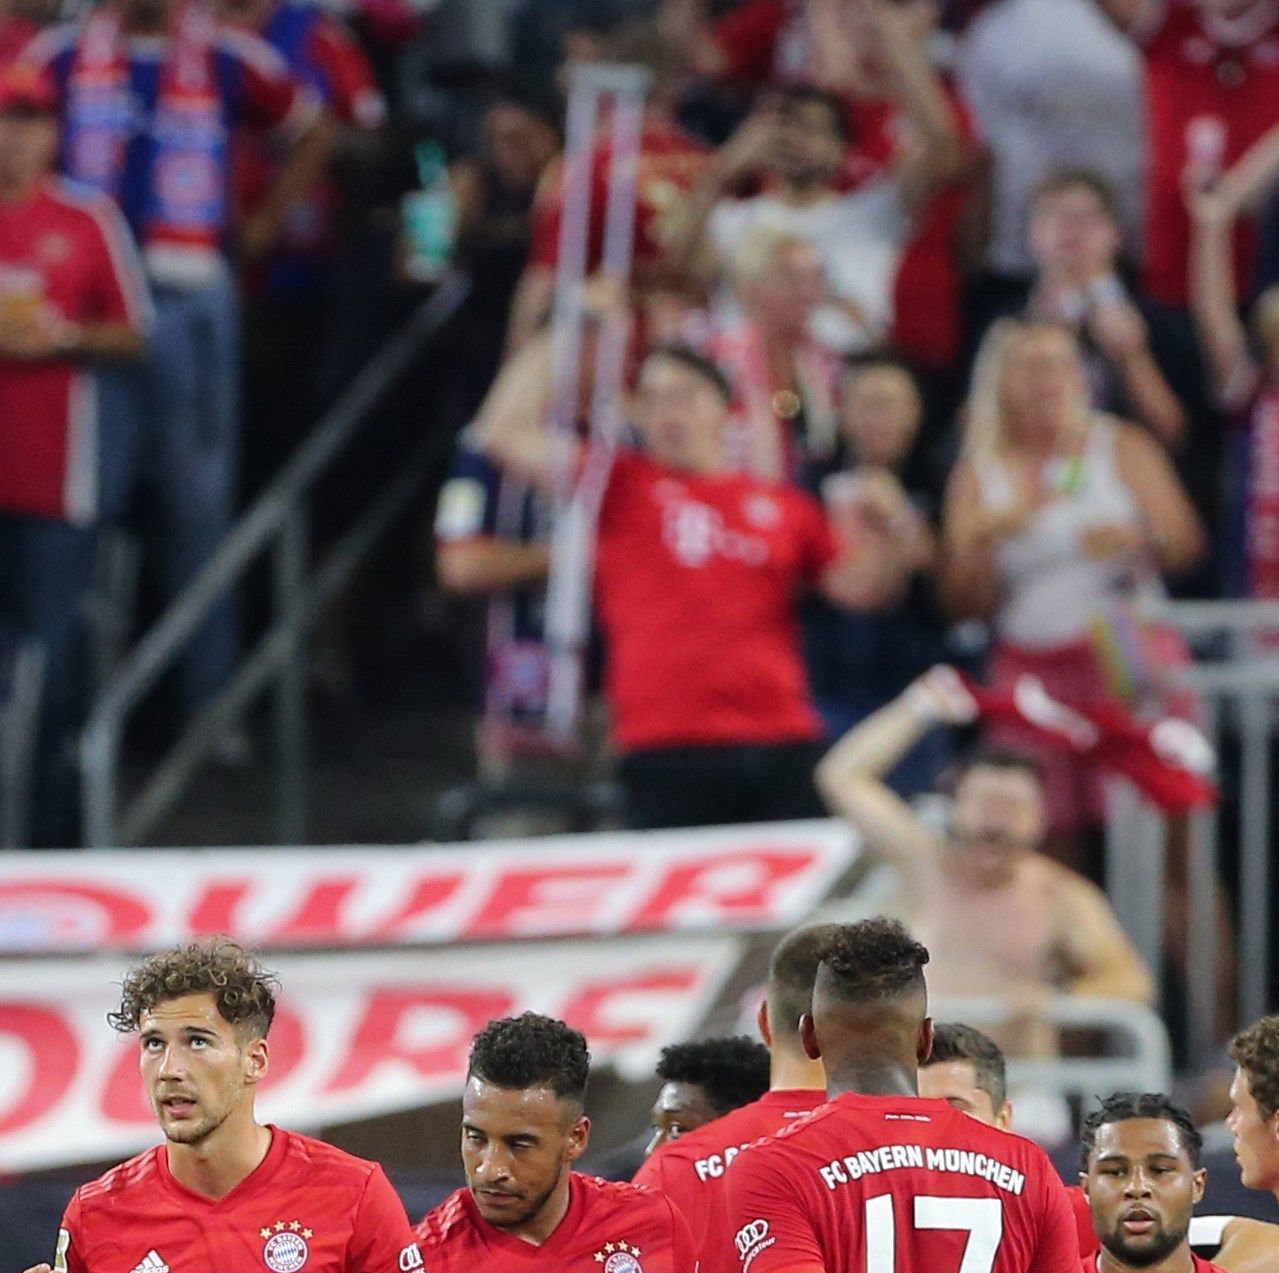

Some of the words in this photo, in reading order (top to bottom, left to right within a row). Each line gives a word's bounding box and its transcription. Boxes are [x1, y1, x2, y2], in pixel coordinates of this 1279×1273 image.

[819, 1159, 847, 1190] FC
[844, 1145, 924, 1180] BAYERN
[925, 1147, 1025, 1196] MÜNCHEN
